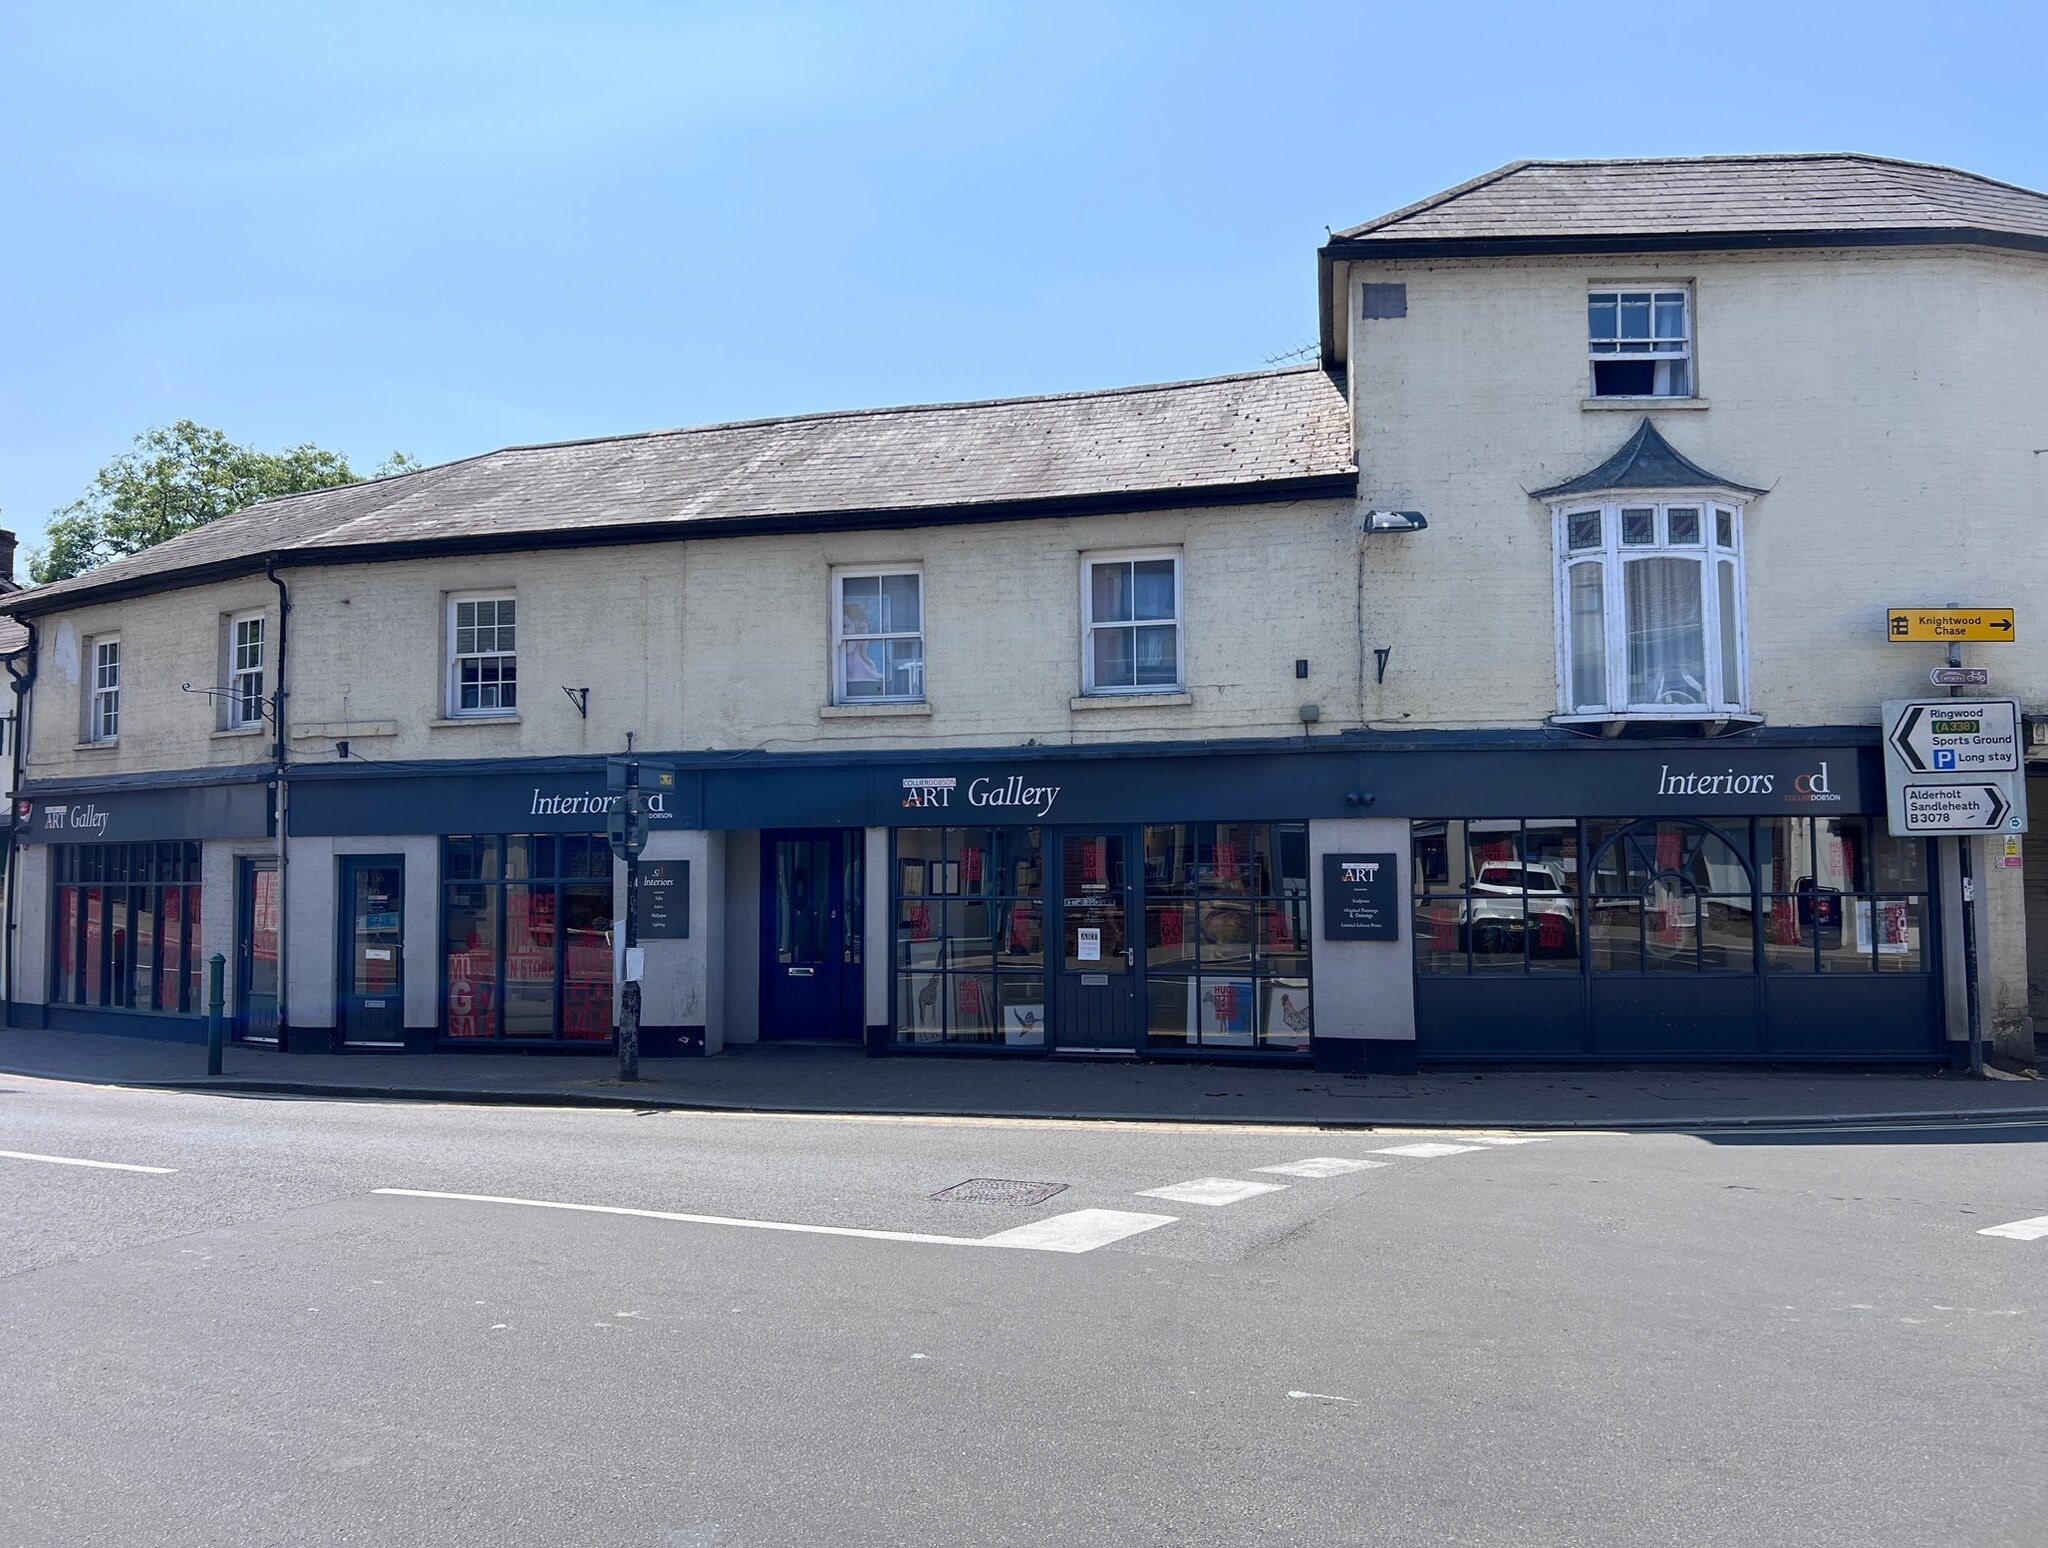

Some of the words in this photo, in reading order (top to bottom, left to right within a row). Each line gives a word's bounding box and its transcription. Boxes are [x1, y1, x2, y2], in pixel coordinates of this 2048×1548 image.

[1919, 616, 1981, 626] Knightwood
[1935, 627, 1966, 635] Chase
[1930, 708, 1983, 719] Ringwood
[1932, 736, 1969, 747] Sports
[1973, 735, 2012, 745] Ground
[1959, 753, 1985, 763] Long
[1988, 752, 2012, 762] stay
[1657, 765, 1774, 795] Interiors
[904, 787, 955, 807] ART
[968, 776, 1060, 817] Gallery
[1910, 790, 1961, 800] Alderholt
[1910, 801, 1980, 811] Sandleheath
[45, 812, 67, 829] ART
[70, 804, 110, 837] Gallery
[1343, 868, 1378, 882] ART
[643, 876, 674, 886] Interiors
[1884, 907, 1906, 916] MUST
[1885, 916, 1908, 931] GO
[450, 958, 496, 980] MU
